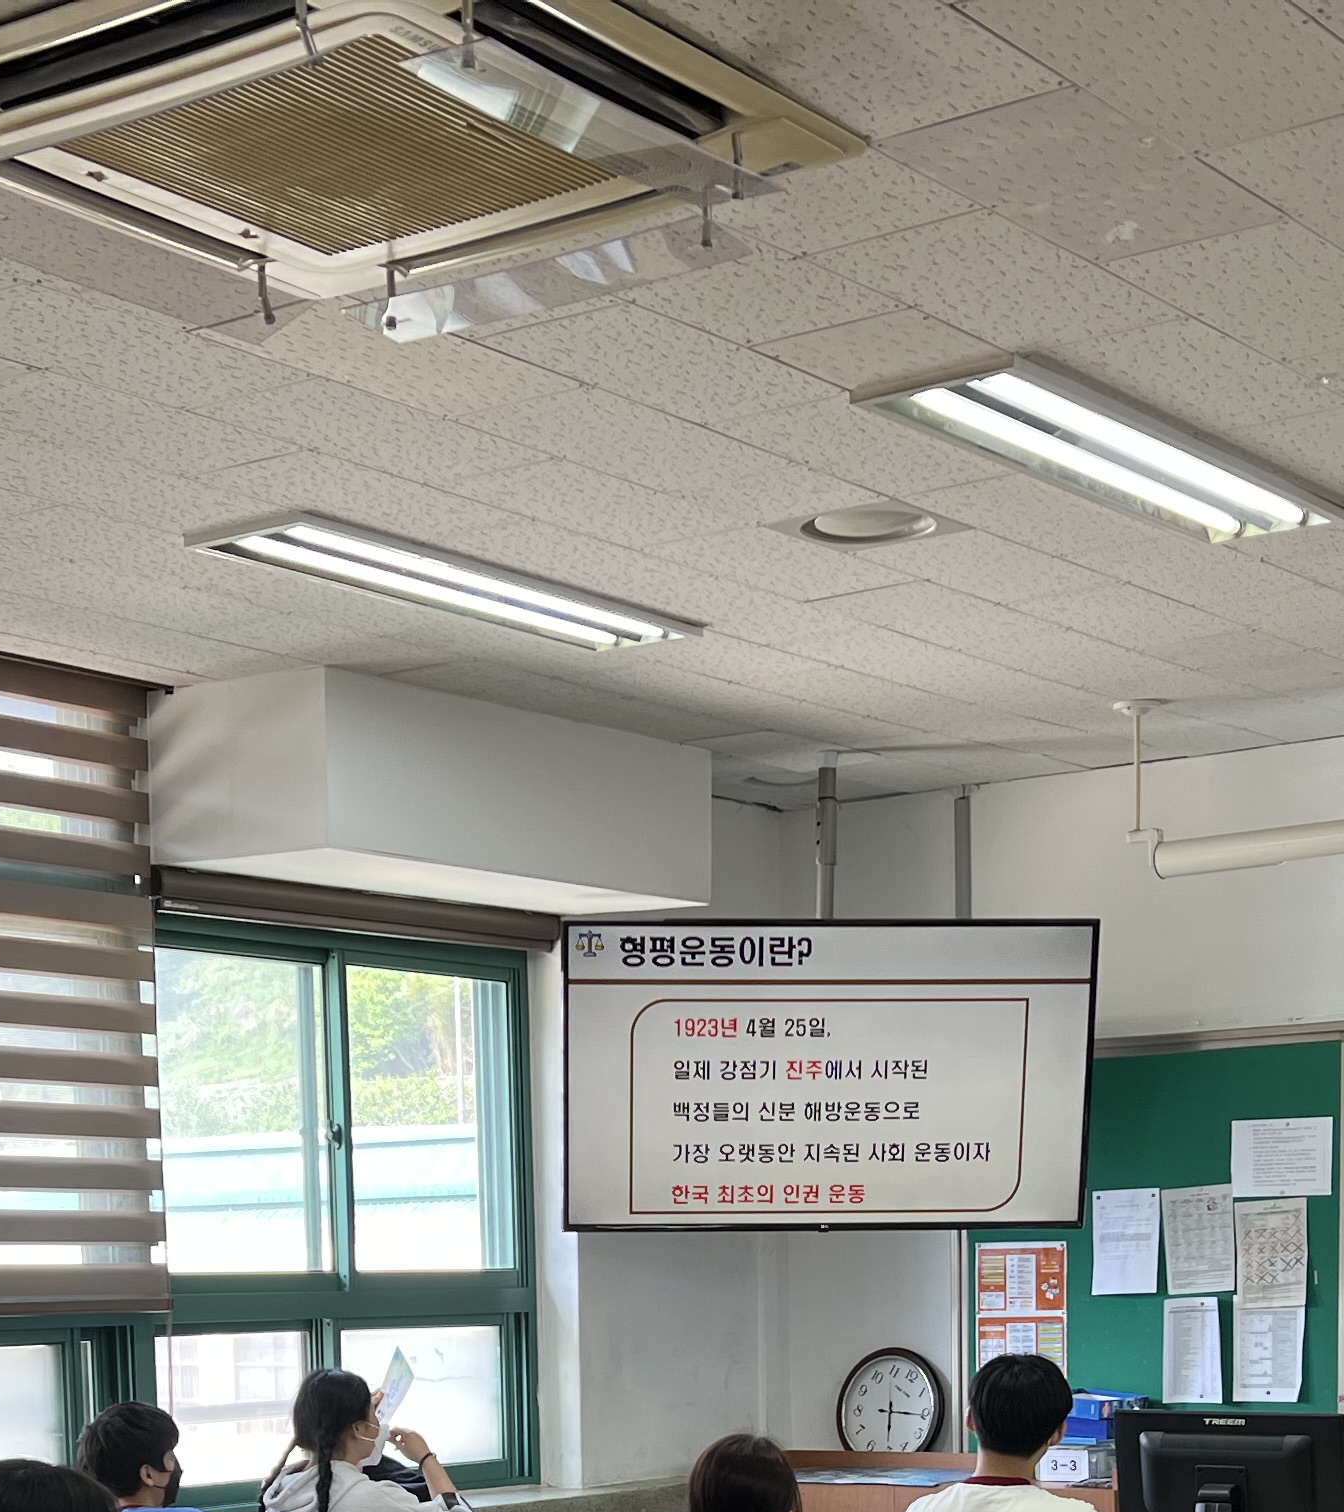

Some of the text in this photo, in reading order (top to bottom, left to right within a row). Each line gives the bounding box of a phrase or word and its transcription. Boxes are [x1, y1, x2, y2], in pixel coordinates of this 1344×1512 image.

[619, 935, 813, 968] 형평운동이란?
[674, 1017, 831, 1038] 1923년 4월 25일,
[673, 1059, 928, 1081] 일제 강점기 진주에서 시작된
[673, 1101, 920, 1123] 백정들의 신분 해방운동으로
[672, 1142, 991, 1164] 가장 오랫동안 지속된 사회 운동이자
[671, 1184, 866, 1205] 한국 최초의 인권 운동
[871, 1369, 884, 1385] 10
[888, 1364, 901, 1379] 11
[906, 1368, 919, 1384] 12
[857, 1384, 868, 1397] 9
[918, 1387, 926, 1398] 1
[853, 1404, 864, 1417] 8
[855, 1424, 866, 1436] 7
[1202, 1417, 1246, 1427] TREEM
[914, 1427, 924, 1440] 3
